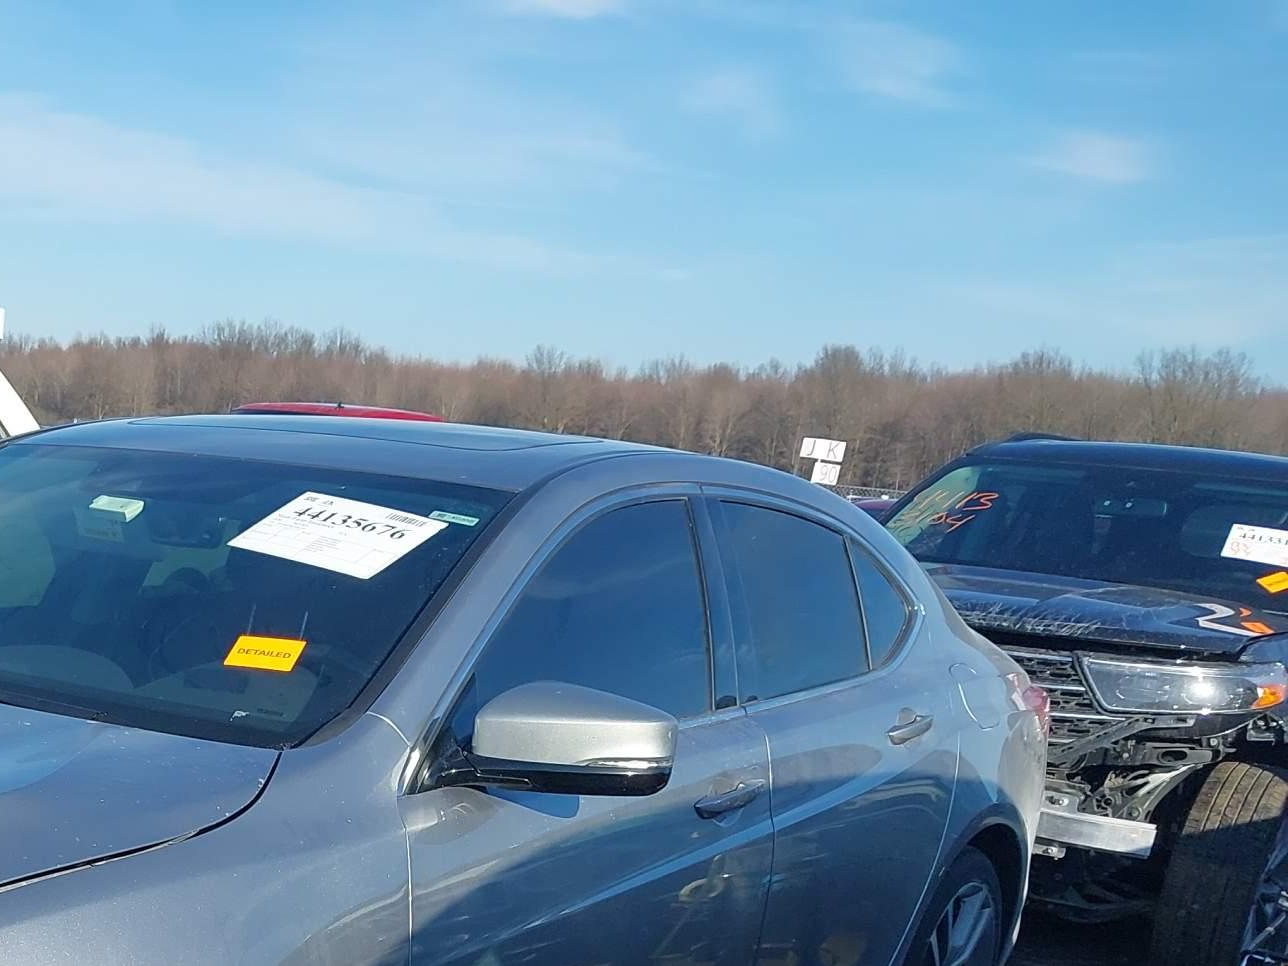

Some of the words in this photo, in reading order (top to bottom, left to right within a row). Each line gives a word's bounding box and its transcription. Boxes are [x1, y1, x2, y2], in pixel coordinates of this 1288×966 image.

[806, 439, 817, 457] J
[826, 440, 841, 460] K
[818, 464, 838, 484] 90
[293, 506, 414, 541] 44135676
[237, 647, 292, 659] DETAILED
